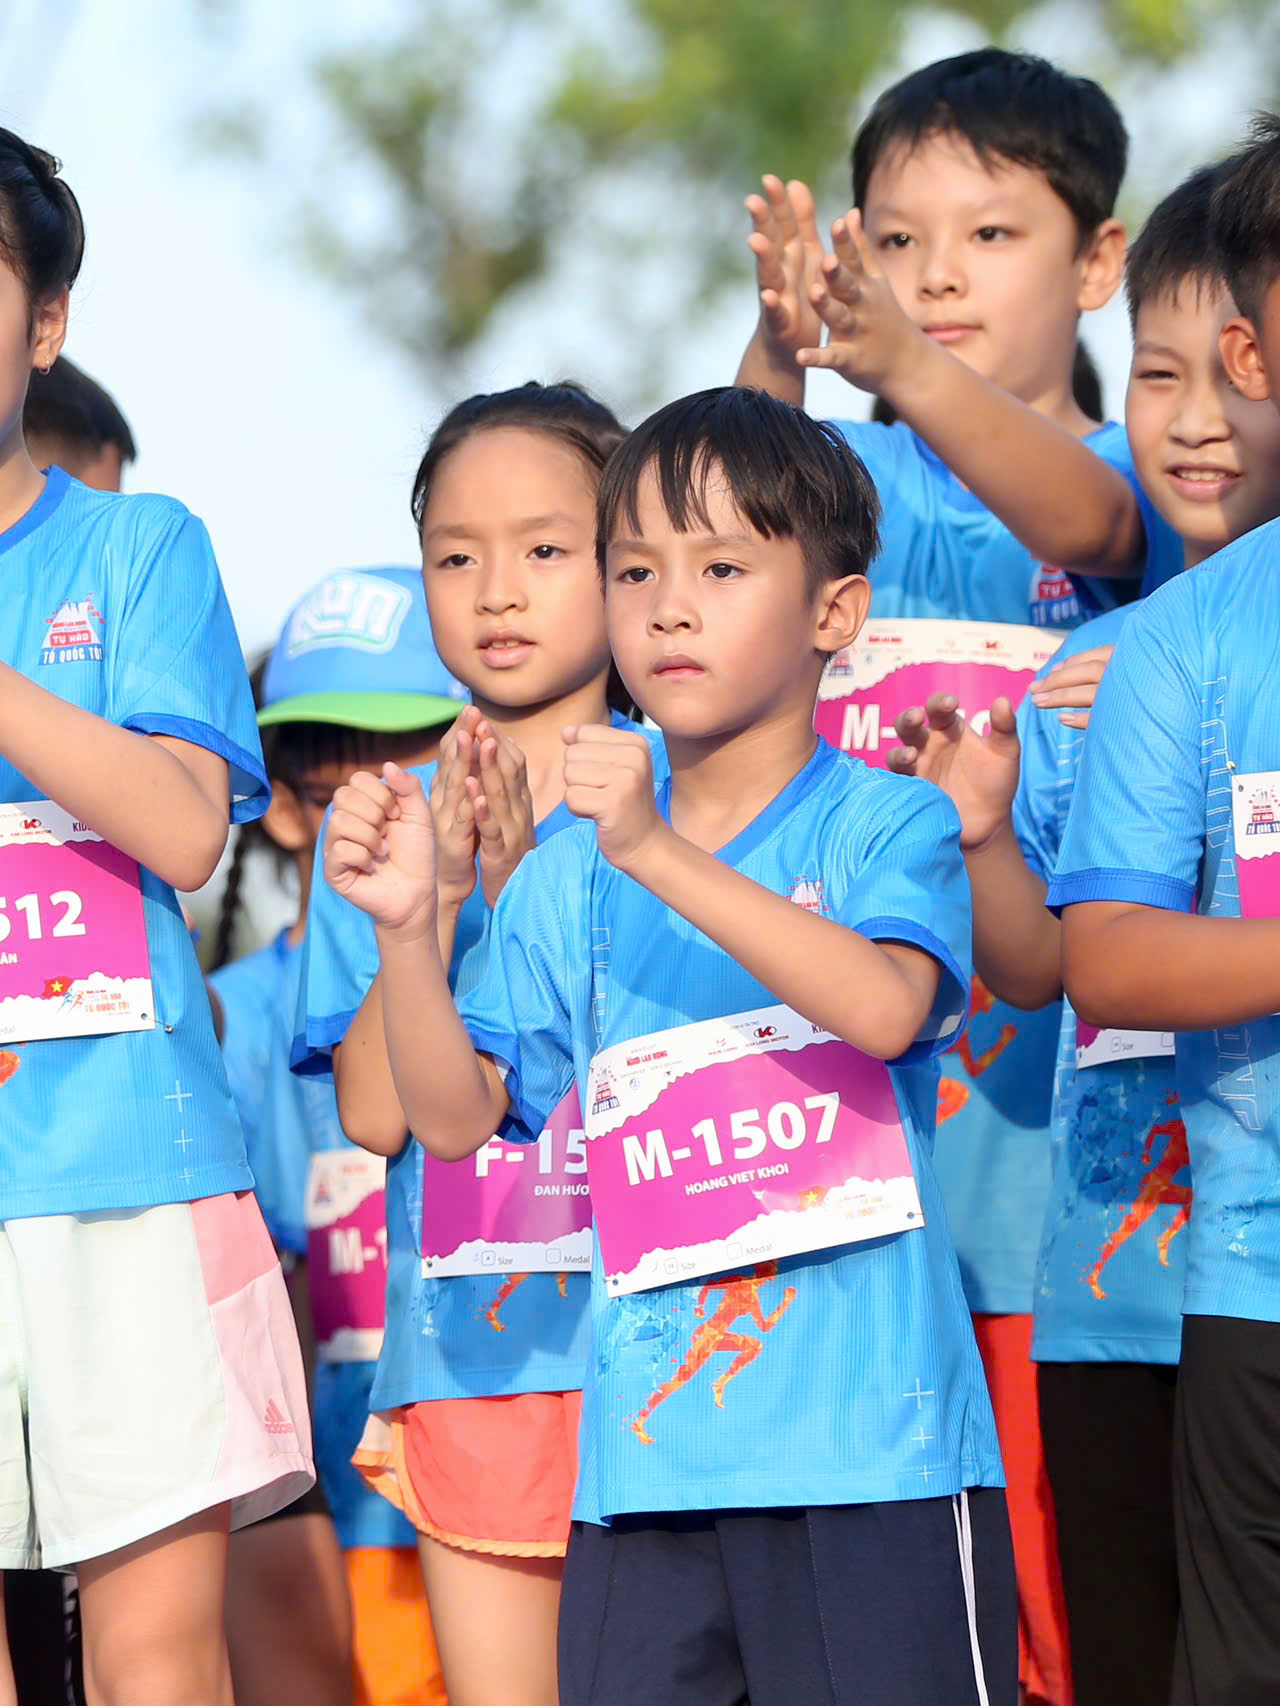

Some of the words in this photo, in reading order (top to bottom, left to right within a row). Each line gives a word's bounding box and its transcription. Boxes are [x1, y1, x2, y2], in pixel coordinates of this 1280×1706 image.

[622, 1091, 841, 1187] M-1507
[685, 1176, 729, 1196] HOANG
[728, 1170, 756, 1186] VIET
[757, 1163, 790, 1180] KHOI
[534, 1185, 560, 1197] ĐAN
[745, 1243, 773, 1255] Medal
[497, 1256, 513, 1265] Size
[563, 1255, 590, 1264] Medal
